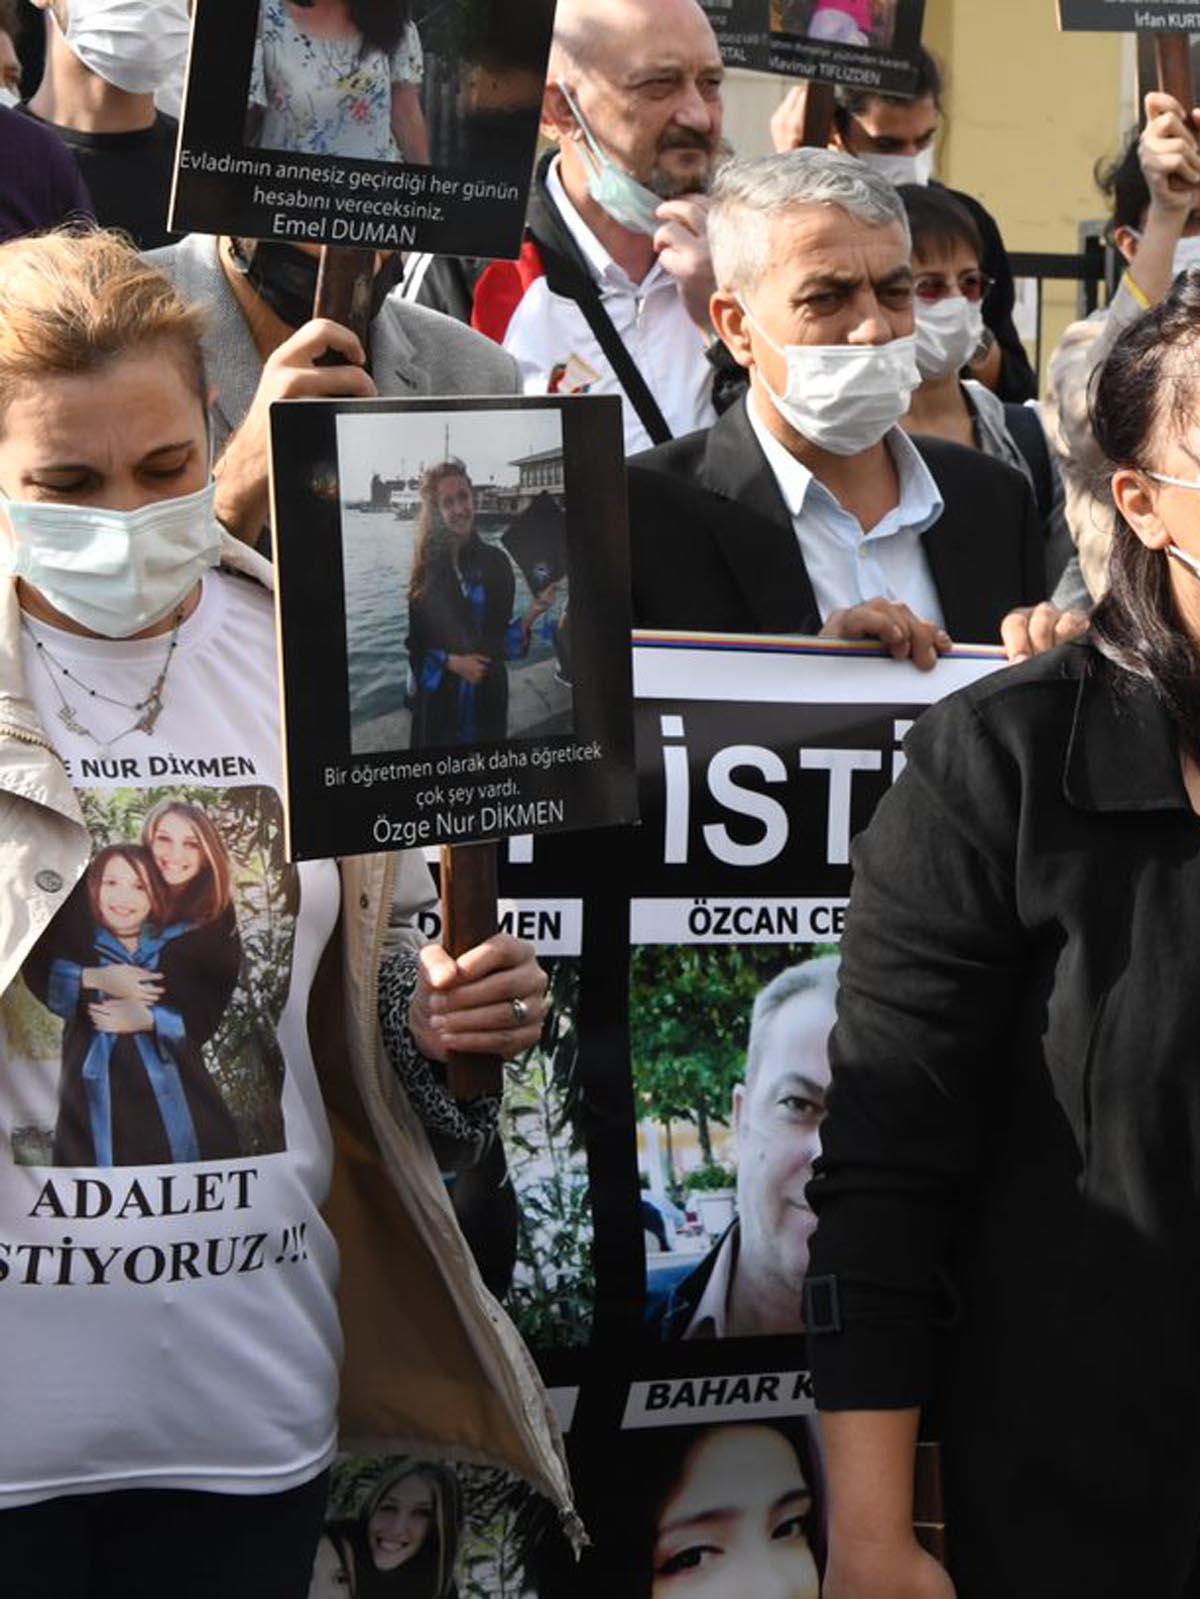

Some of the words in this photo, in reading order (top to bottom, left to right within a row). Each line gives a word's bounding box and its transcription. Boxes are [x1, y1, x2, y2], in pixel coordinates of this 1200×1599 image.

[179, 150, 271, 177] Evladımın
[275, 161, 345, 184] annesiz
[349, 169, 426, 196] geçirdiği
[430, 175, 459, 195] her
[463, 180, 519, 203] günün
[253, 186, 332, 210] hesabını
[335, 197, 445, 222] vereceksiniz.
[273, 213, 327, 239] Emel
[332, 218, 416, 246] DUMAN
[81, 759, 141, 779] NUR
[149, 753, 257, 778] DİKMEN
[325, 767, 347, 787] Bir
[351, 760, 432, 788] öğretmen
[436, 752, 485, 776] olarak
[488, 748, 528, 769] daha
[530, 741, 602, 769] öğreticek
[416, 788, 444, 810] çok
[448, 787, 473, 806] şey
[478, 777, 521, 800] vardı.
[373, 815, 431, 846] Özge
[436, 812, 475, 836] Nur
[480, 799, 564, 832] DİKMEN
[688, 898, 798, 936] ÖZCAN
[28, 1168, 258, 1220] ADALET
[645, 1376, 780, 1411] BAHAR
